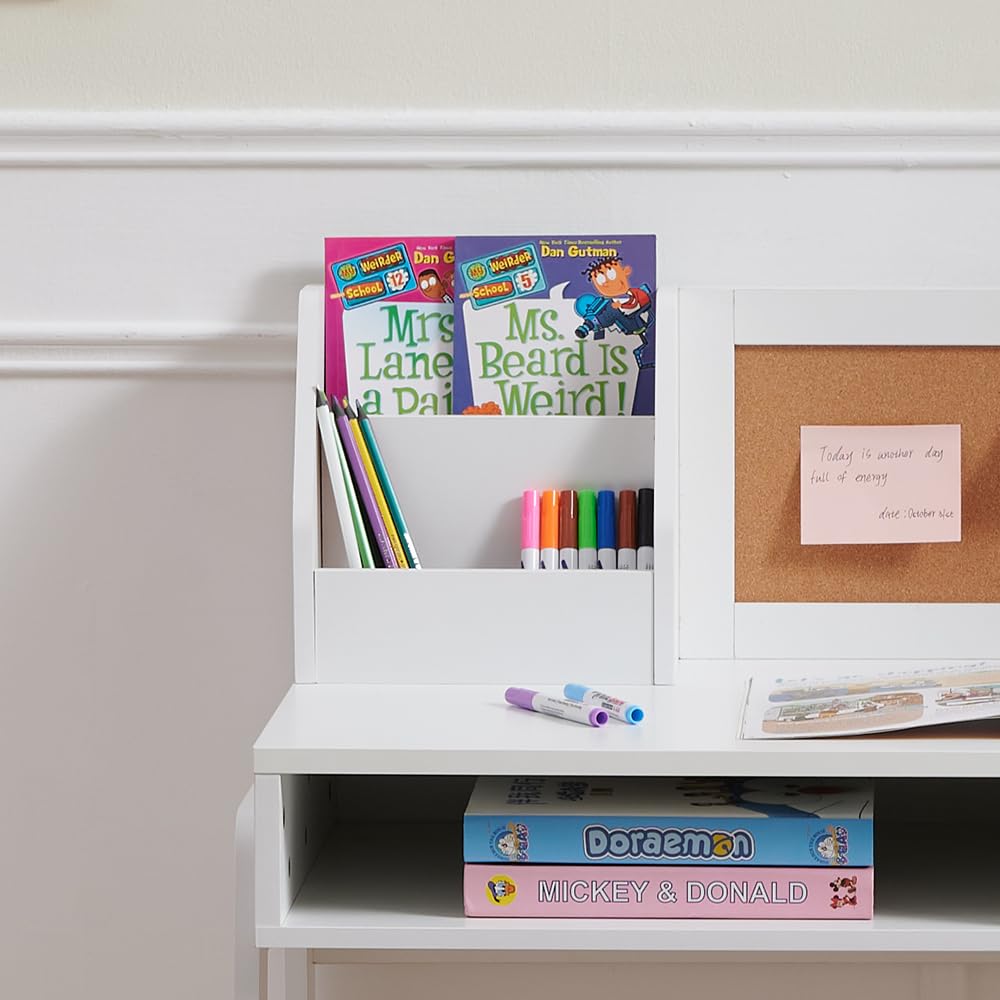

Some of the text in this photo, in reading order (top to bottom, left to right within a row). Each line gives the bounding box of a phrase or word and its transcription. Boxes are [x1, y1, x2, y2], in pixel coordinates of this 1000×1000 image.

[414, 251, 439, 264] Dan
[541, 245, 617, 257] Dan Gutman
[391, 273, 405, 287] 12
[521, 274, 531, 288] 5
[504, 302, 565, 344] Ms.
[356, 342, 454, 381] Lane
[475, 339, 590, 379] Beard
[362, 388, 384, 415] a
[820, 445, 944, 467] Today is another day
[810, 469, 889, 487] full of energy
[583, 824, 756, 860] Doraemon
[537, 880, 808, 905] MICKEY & DONALD
